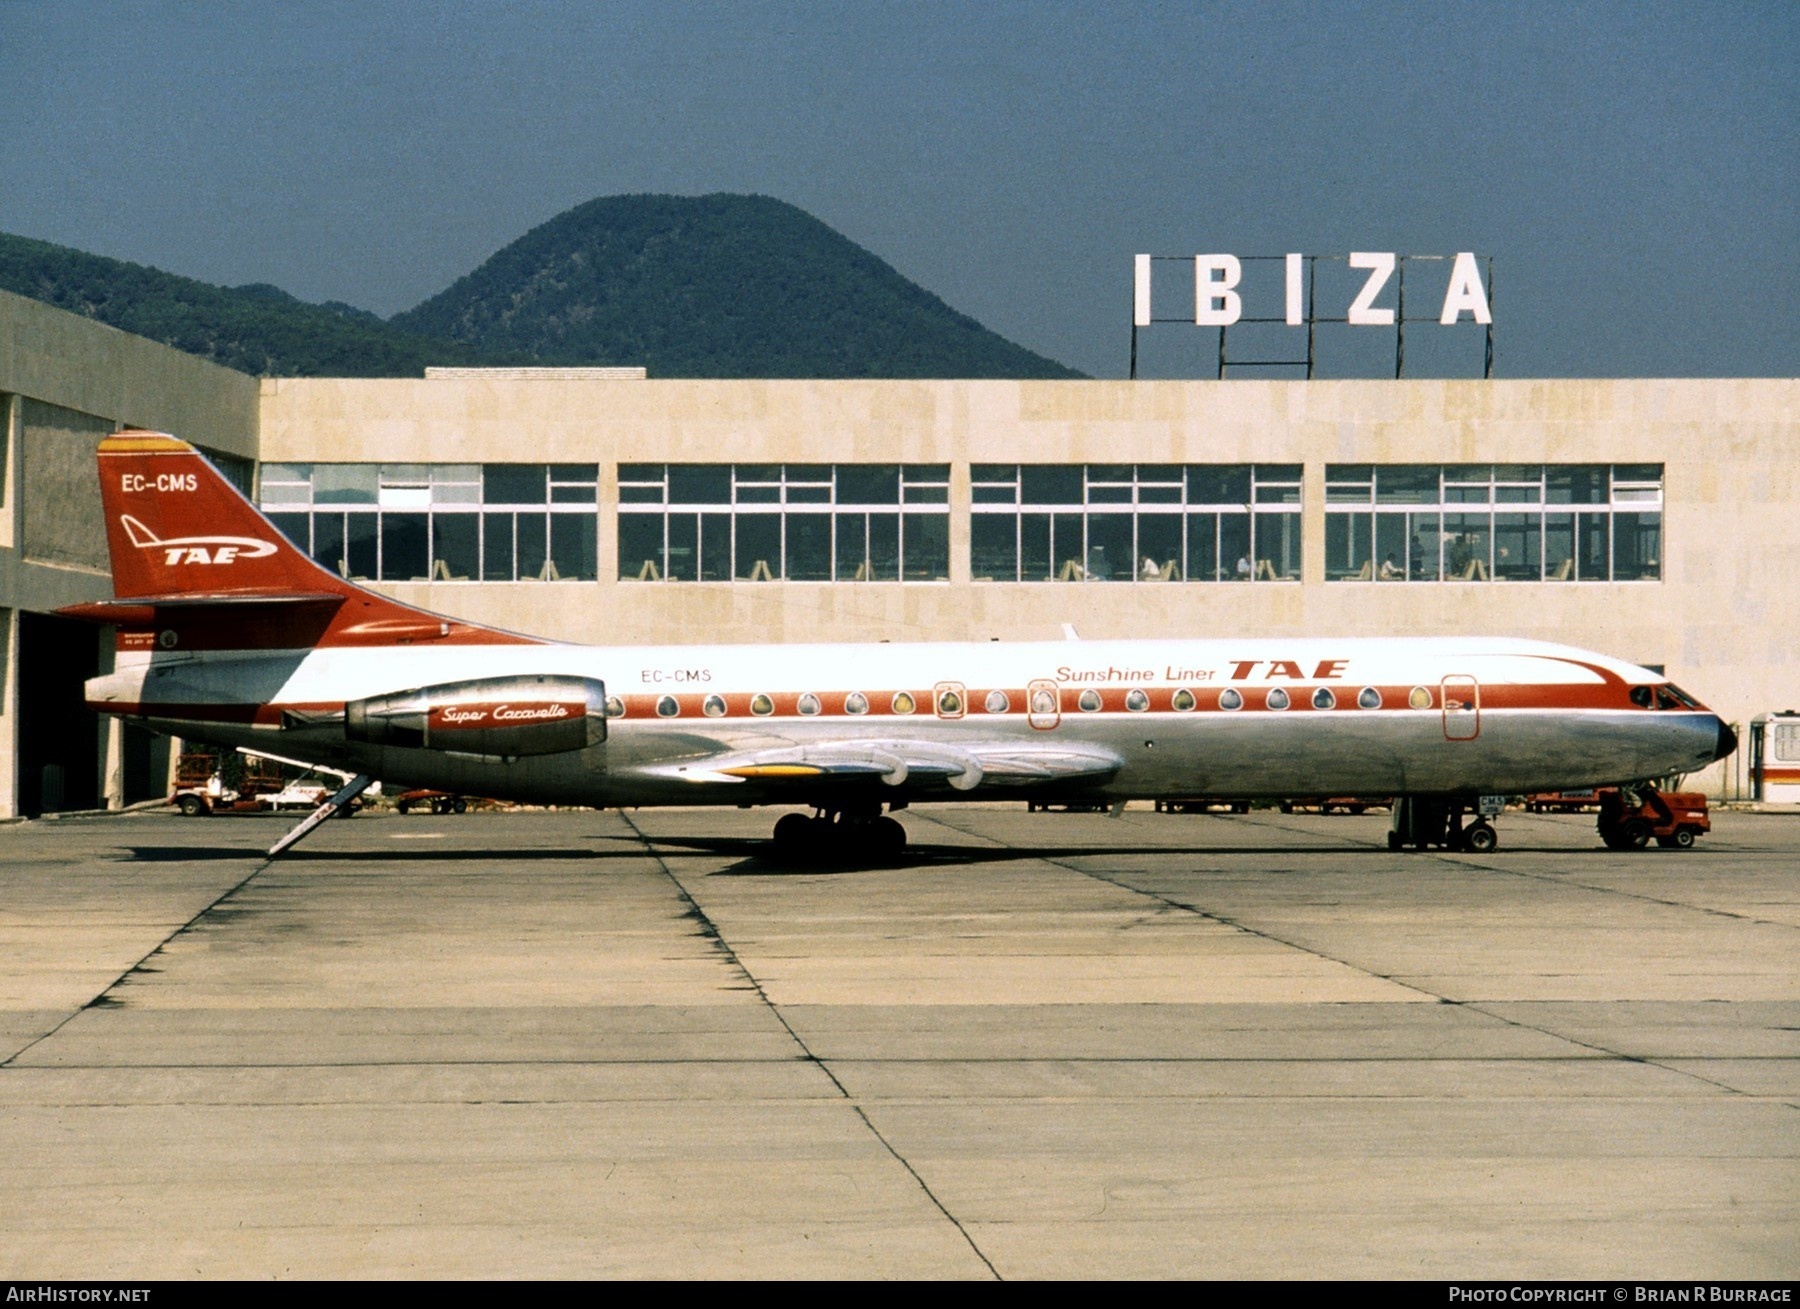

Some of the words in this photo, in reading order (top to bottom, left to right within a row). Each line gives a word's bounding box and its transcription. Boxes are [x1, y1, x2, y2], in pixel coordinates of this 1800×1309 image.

[1134, 252, 1492, 326] IBIZA
[121, 474, 198, 492] EC-CMS
[164, 547, 240, 566] TAE
[641, 669, 712, 683] EC-CMS
[1055, 666, 1155, 682] Sunshine
[1165, 665, 1216, 681] Liner
[1228, 660, 1350, 680] TAE
[441, 707, 488, 724] Super
[493, 704, 569, 720] Caravelle
